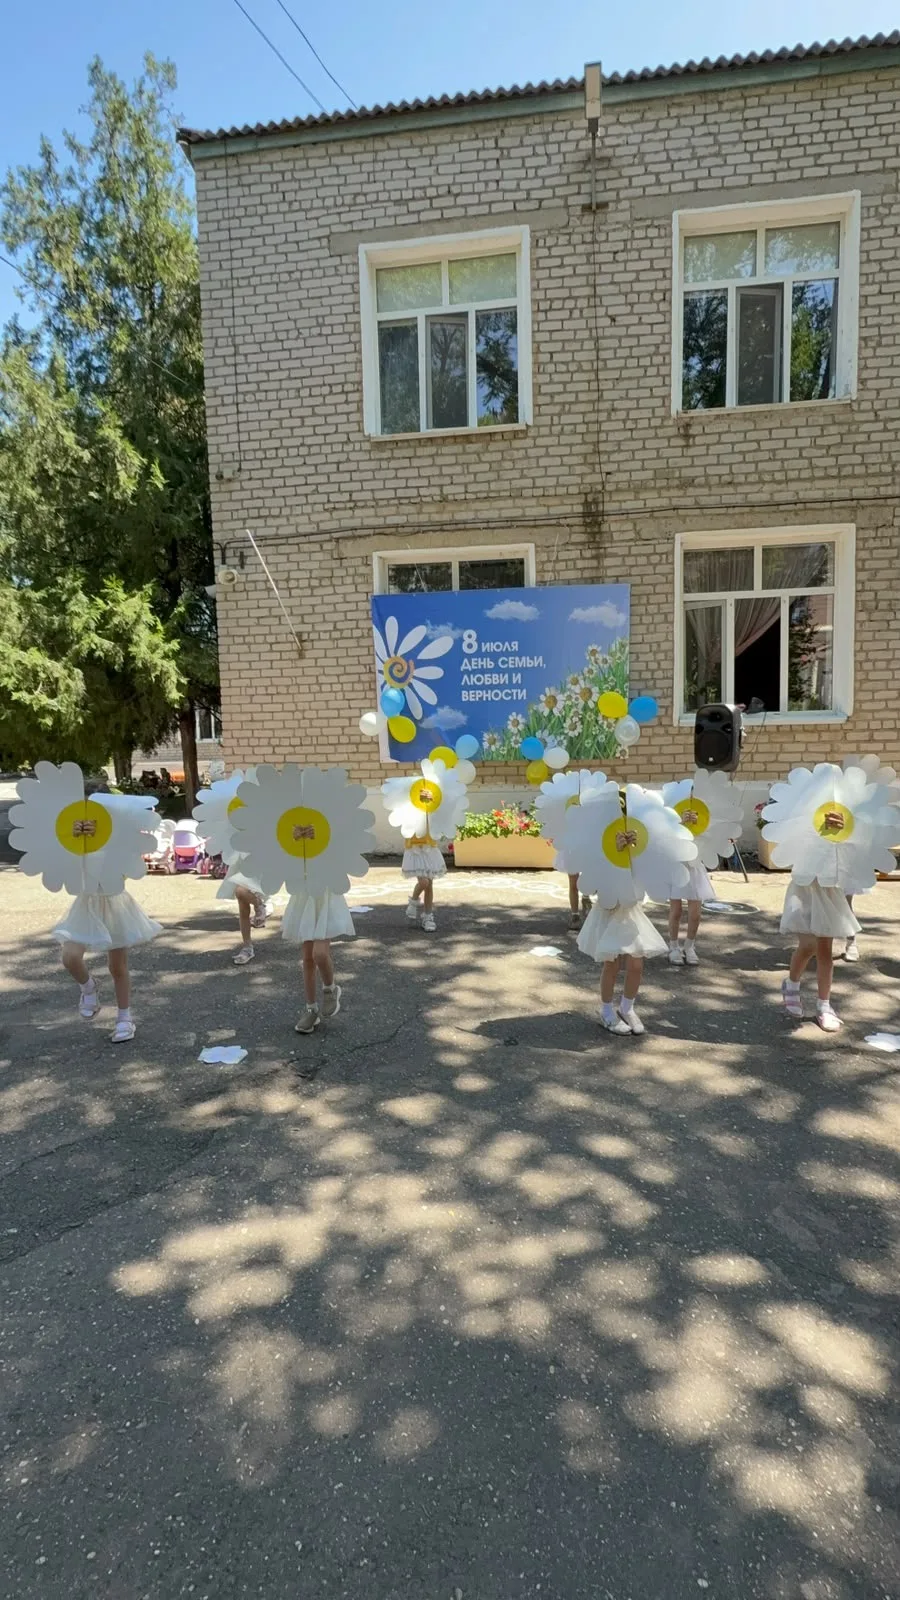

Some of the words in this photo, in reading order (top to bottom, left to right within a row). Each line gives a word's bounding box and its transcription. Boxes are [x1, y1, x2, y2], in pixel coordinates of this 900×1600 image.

[462, 629, 478, 654] 8
[481, 641, 519, 652] ИЮЛЯ
[460, 657, 495, 671] ДЕНЬ
[498, 656, 546, 669] СЕМЬИ,
[461, 673, 508, 685] ЛЮБВИ
[513, 673, 522, 684] И
[461, 689, 527, 702] ВЕРНОСТИ
